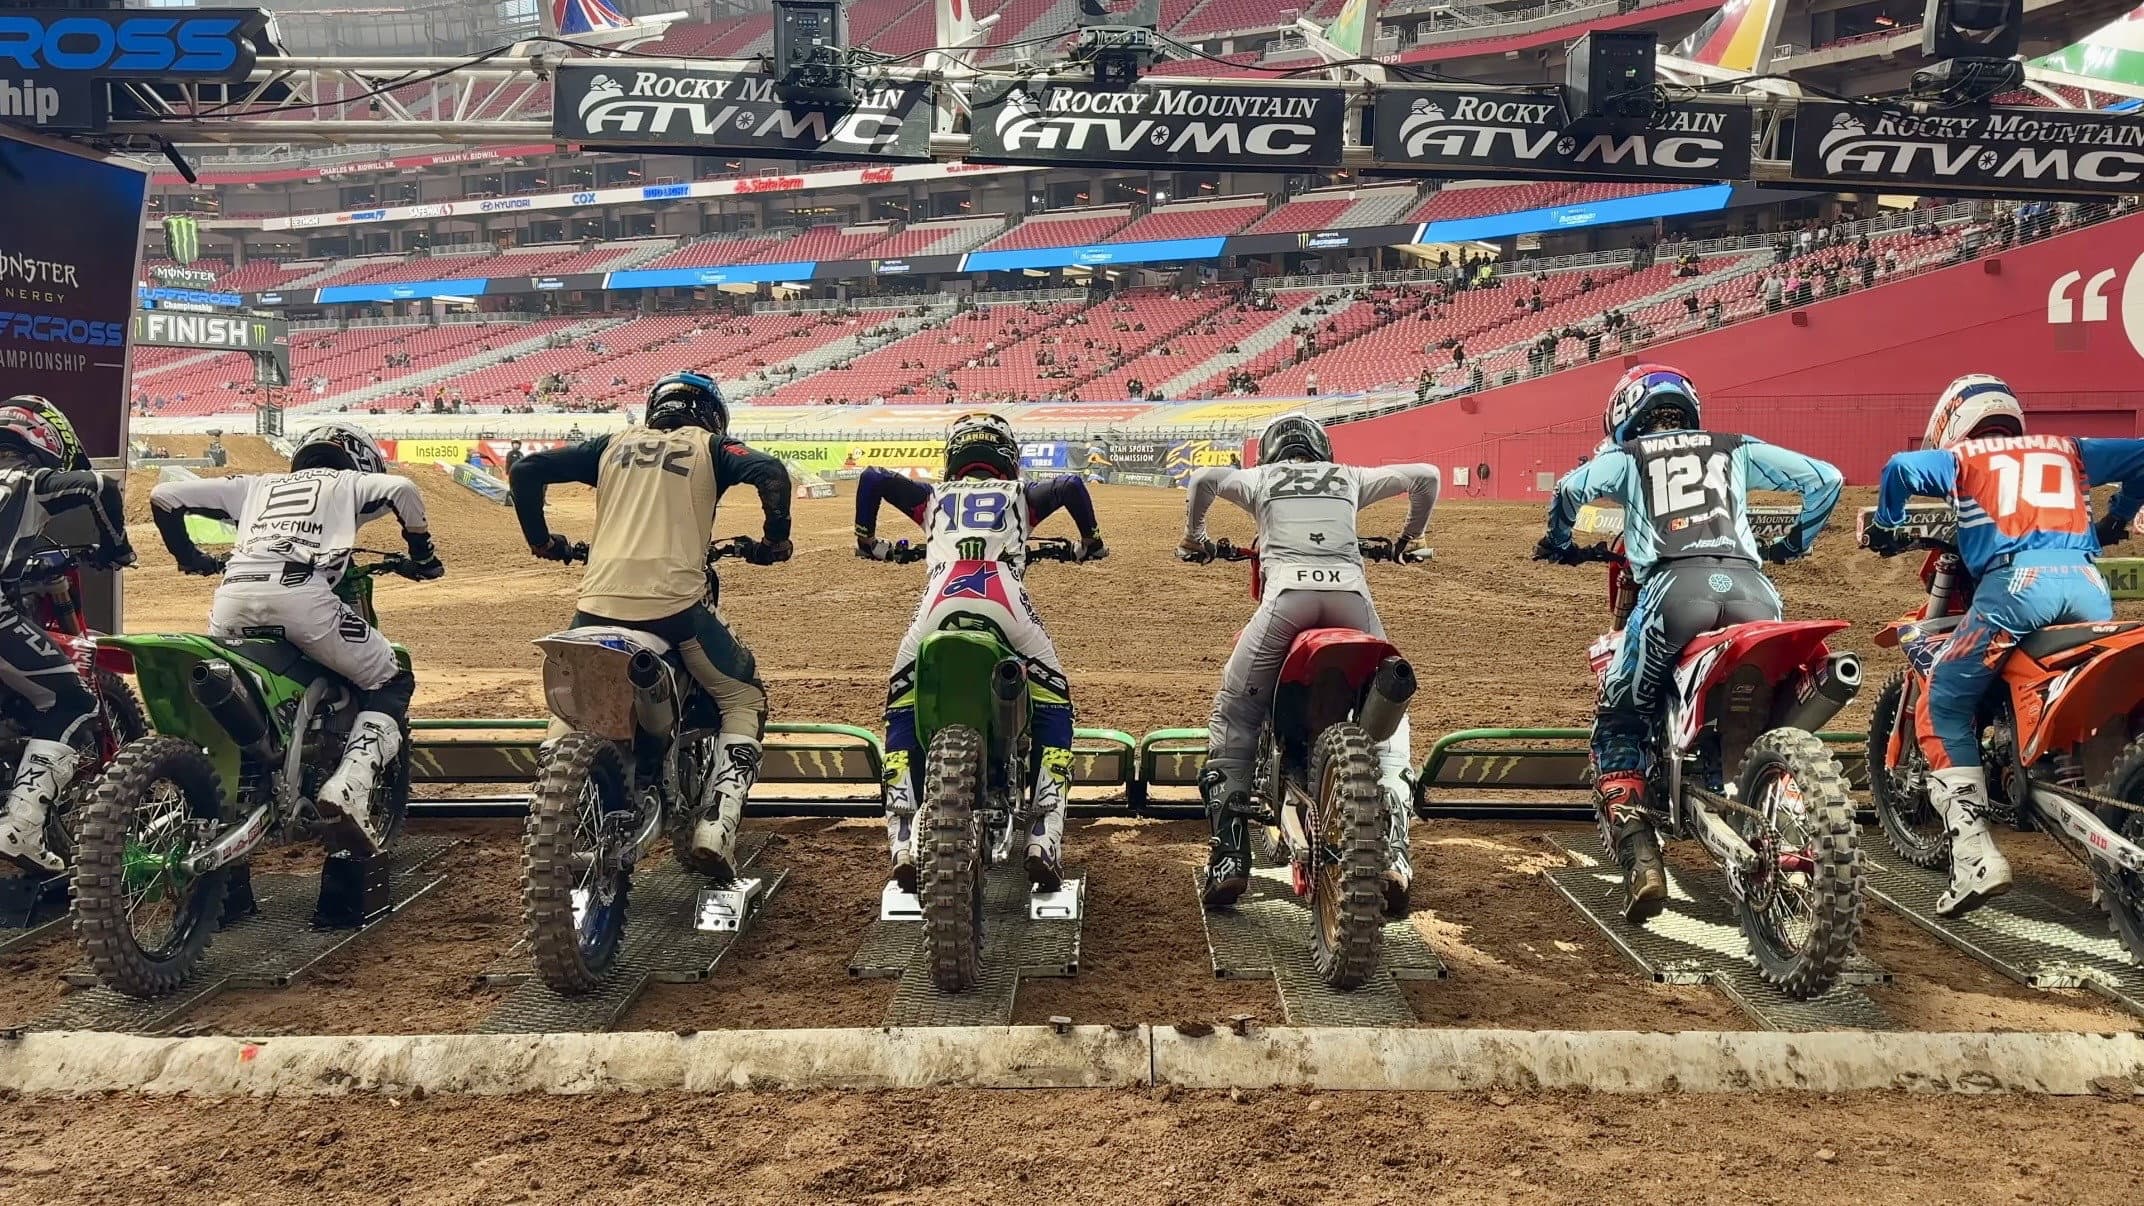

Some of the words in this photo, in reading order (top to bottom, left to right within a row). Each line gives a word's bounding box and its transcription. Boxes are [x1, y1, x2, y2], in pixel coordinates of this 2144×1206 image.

[629, 72, 733, 100] ROCKY
[737, 77, 905, 110] MAIN
[1047, 87, 1149, 115] ROCKY
[1151, 90, 1319, 119] MOUNTAIN
[1454, 96, 1555, 125] ROCKY
[1872, 111, 1977, 139] ROCKY
[494, 198, 531, 209] HYUNDAI
[572, 192, 596, 204] COX
[147, 314, 249, 345] FINISH
[415, 444, 459, 458] Insta360
[763, 447, 828, 461] Kawasaki
[867, 447, 945, 458] DUNLOP
[1110, 454, 1154, 462] COMMISSION
[1268, 466, 1350, 498] 256
[938, 490, 1010, 534] 18
[271, 520, 323, 535] VENUM
[1296, 569, 1341, 583] FOX
[13, 622, 60, 657] FLY
